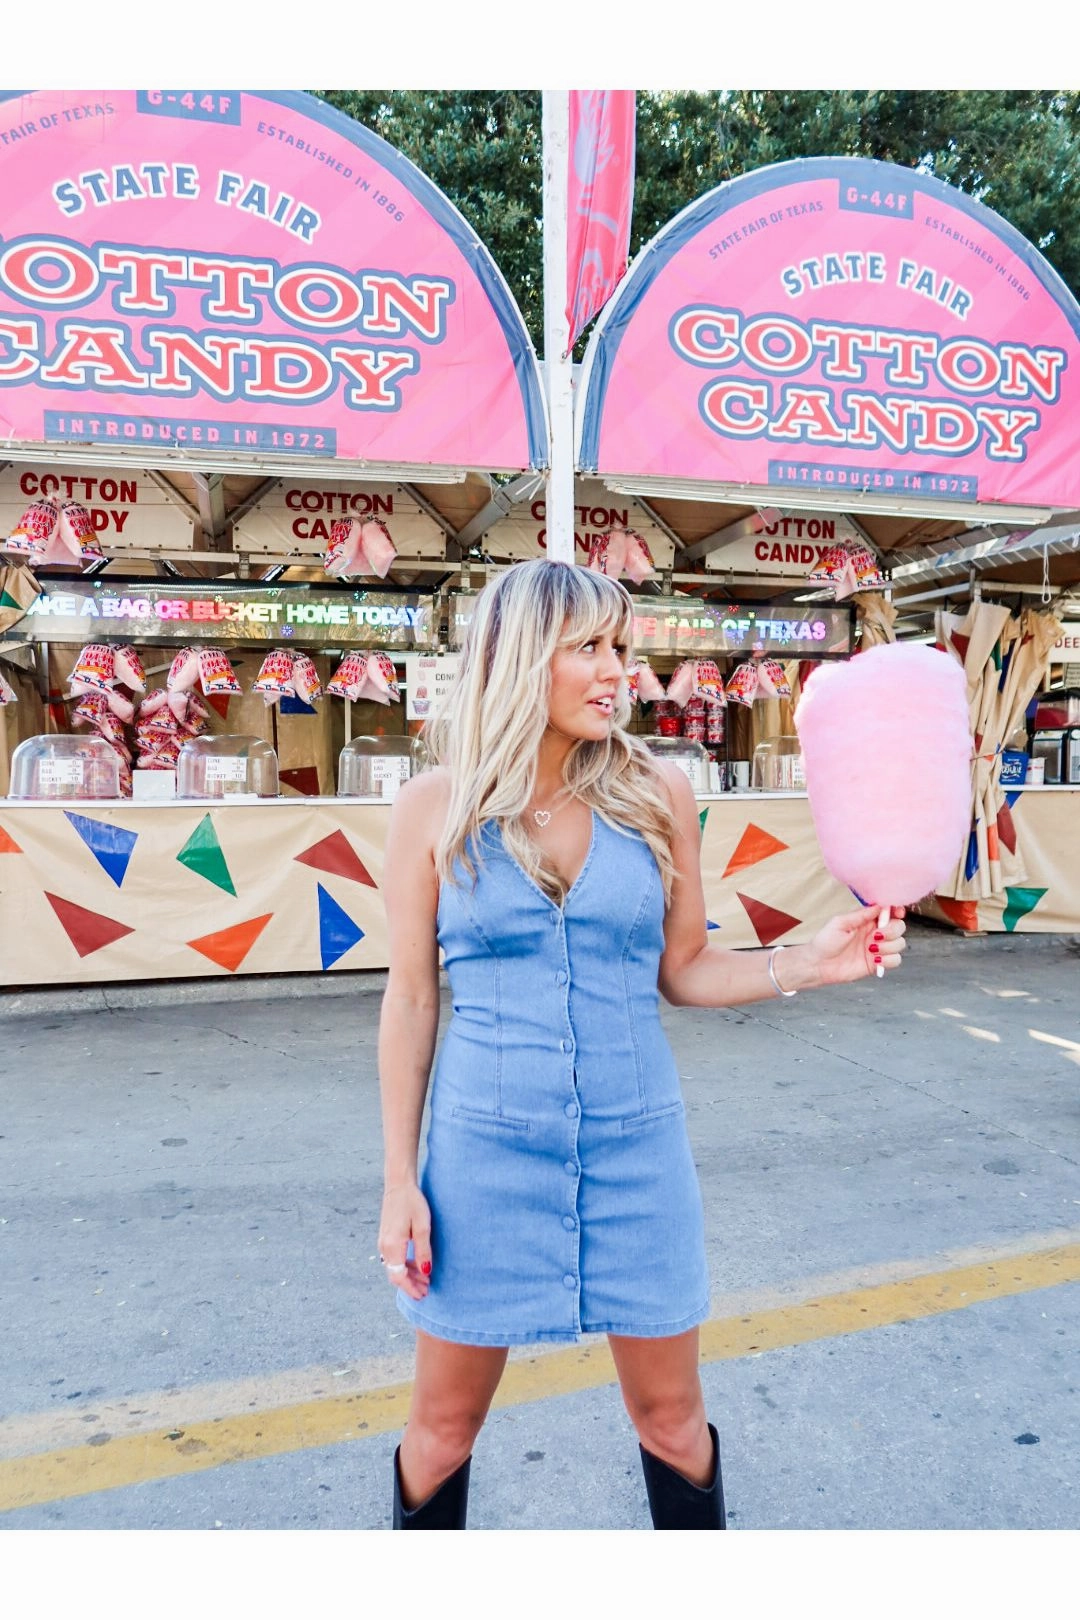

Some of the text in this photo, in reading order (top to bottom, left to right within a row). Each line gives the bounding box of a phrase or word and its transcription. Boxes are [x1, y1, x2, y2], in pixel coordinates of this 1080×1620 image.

[147, 90, 232, 114] G-44F
[0, 102, 115, 146] FAIR OF TEXAS
[257, 121, 405, 222] ESTABLISHED IN 1886
[54, 163, 320, 243] STATE FAIR
[846, 187, 907, 211] G-44F
[708, 200, 824, 260] STATE FAIR OF TEXAS
[925, 216, 1030, 301] ESTABLISHED IN 1886
[0, 241, 449, 338] OTTON
[781, 253, 973, 320] STATE FAIR
[674, 310, 1063, 400] COTTON
[59, 419, 325, 449] INTRODUCED IN 1972
[704, 381, 1036, 457] CANDY
[20, 472, 137, 503] COTTON
[778, 467, 970, 492] INTRODUCED IN 1972
[285, 489, 393, 515] COTTON
[531, 500, 628, 528] CTON
[754, 517, 835, 540] OTTON
[26, 595, 424, 626] AKE A BAG OR BUCKET HOME TODAY
[721, 619, 751, 640] OF
[755, 620, 826, 641] TEXAS
